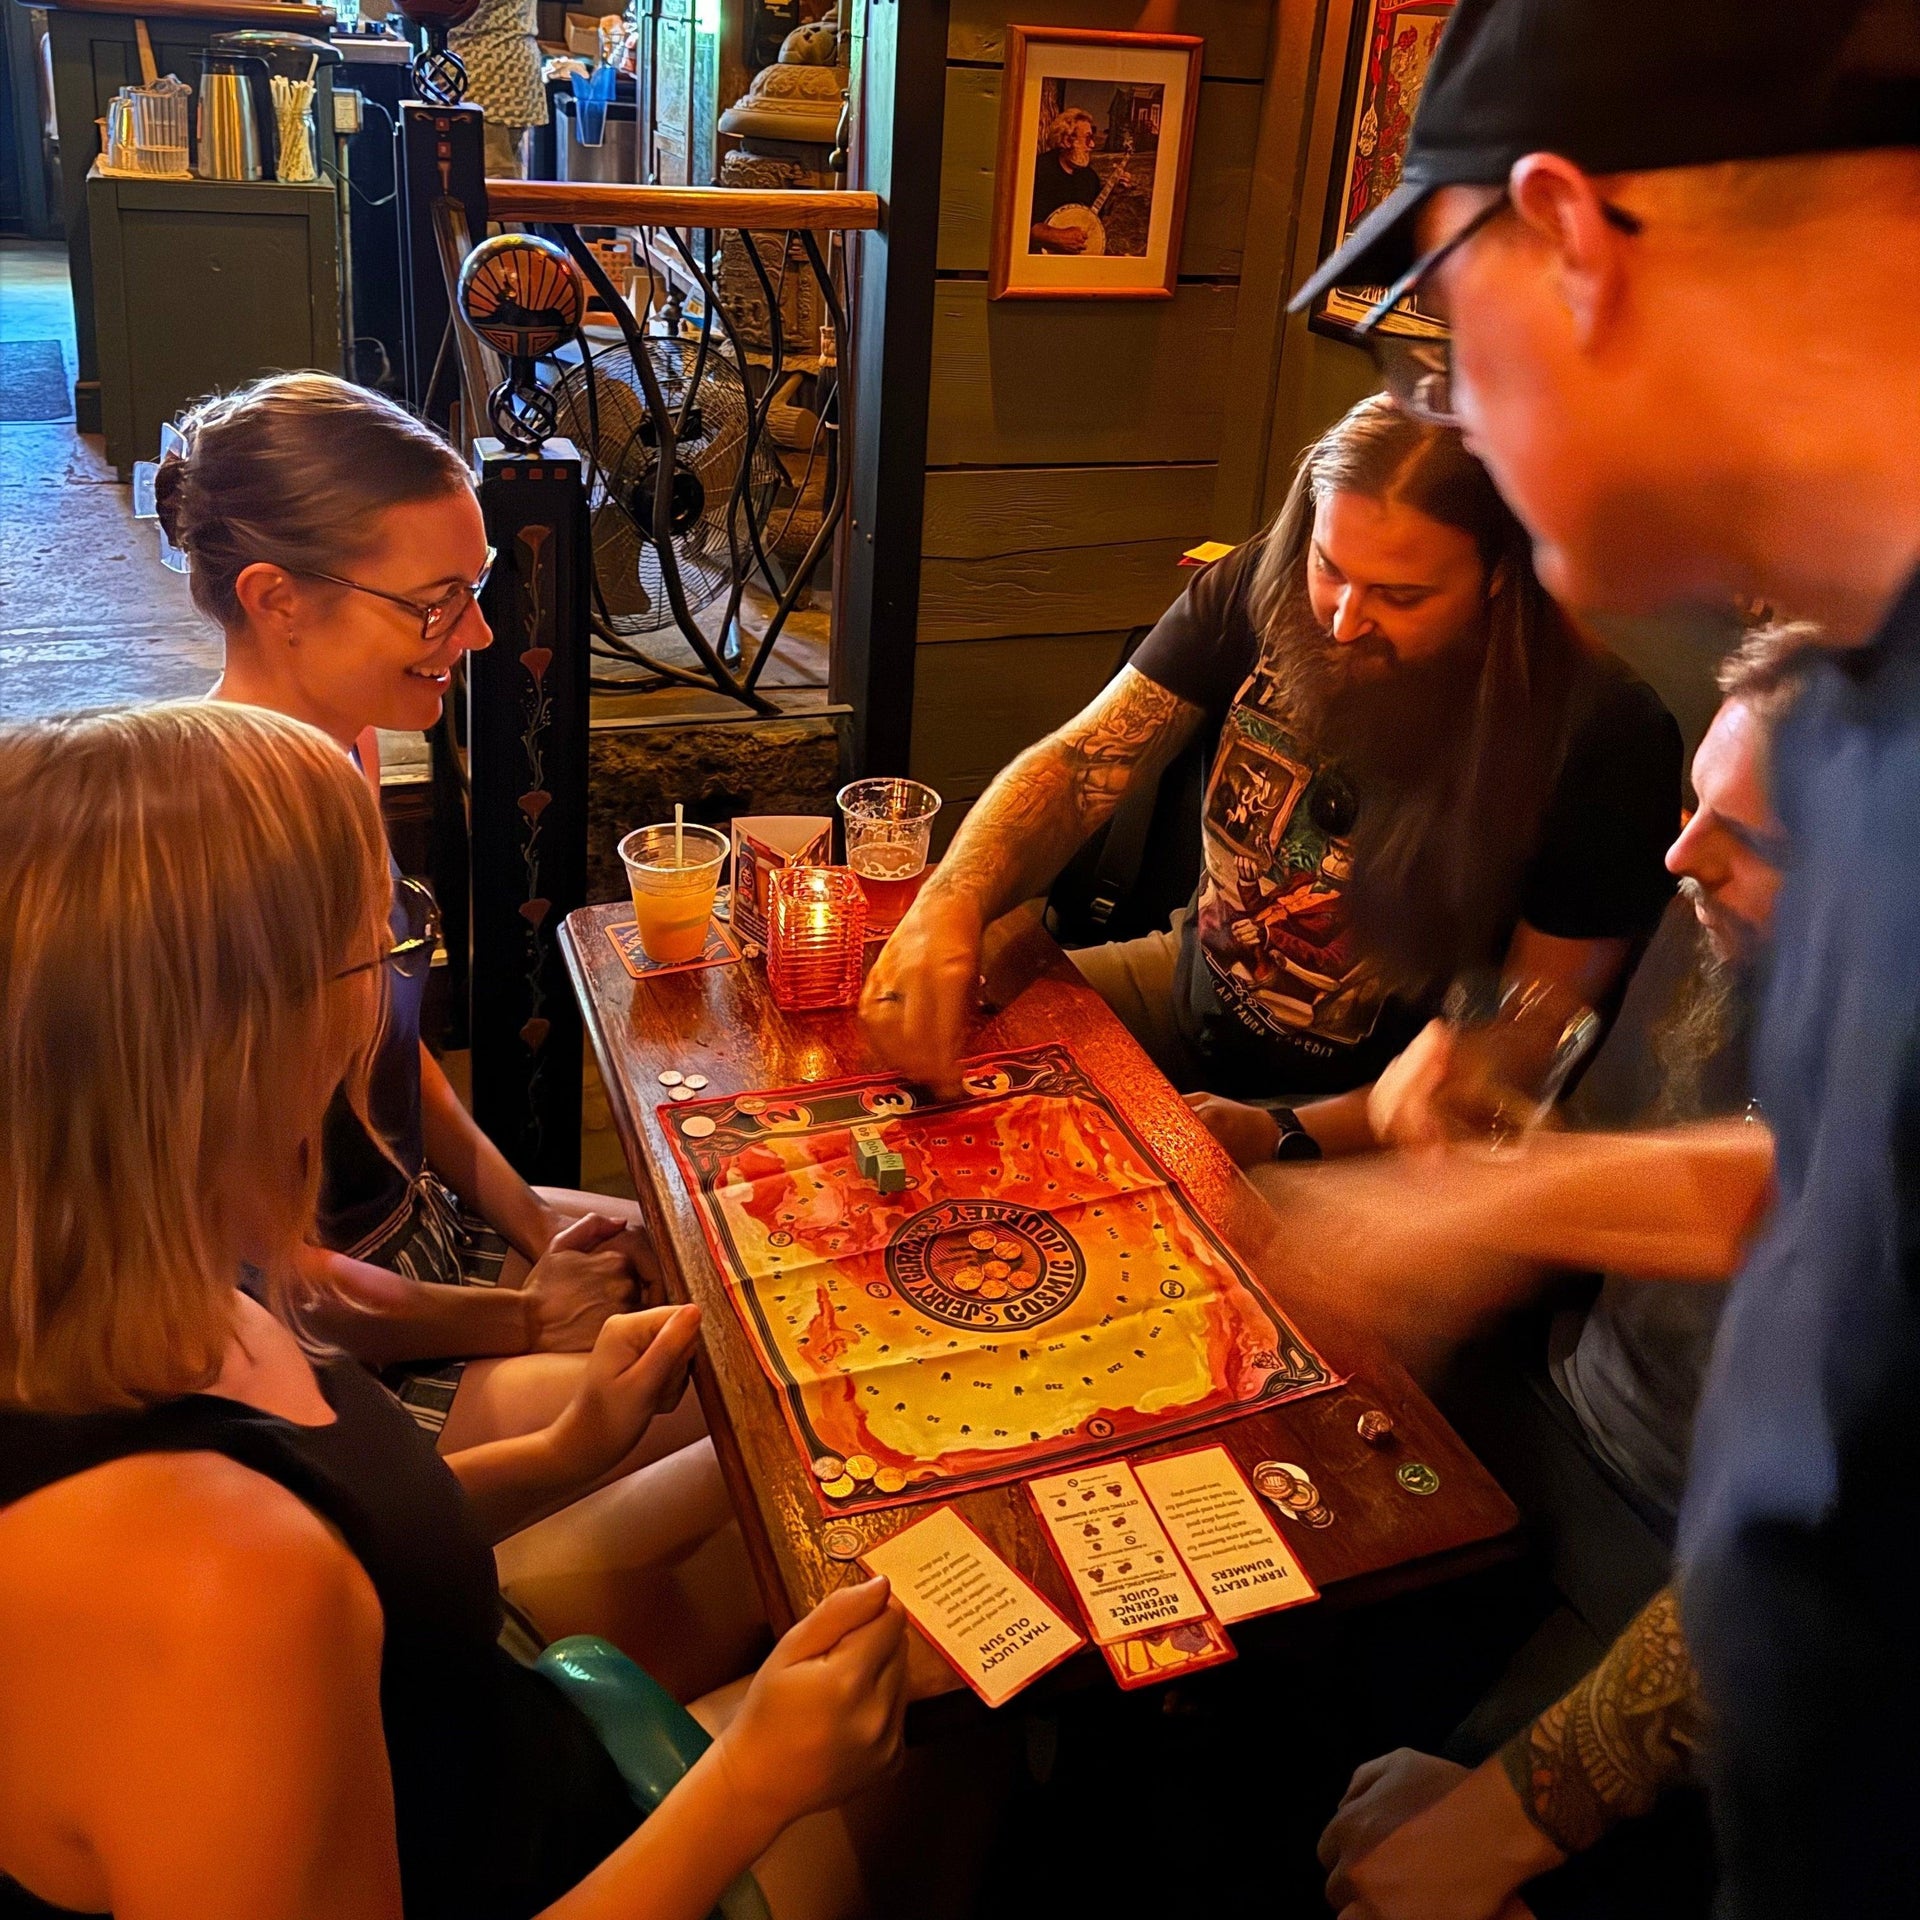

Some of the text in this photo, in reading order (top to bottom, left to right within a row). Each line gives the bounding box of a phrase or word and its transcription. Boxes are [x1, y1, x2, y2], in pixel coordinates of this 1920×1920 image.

[968, 1075, 997, 1090] 4
[872, 1093, 905, 1106] 3
[767, 1109, 800, 1123] 2
[865, 1140, 879, 1154] 100
[949, 1206, 1075, 1322] COSMIC JOURNEY
[909, 1283, 981, 1321] JERRY
[1107, 1362, 1124, 1373] 220
[866, 1385, 880, 1396] 60
[973, 1380, 993, 1390] 240
[1044, 1382, 1064, 1391] 230
[927, 1415, 941, 1424] 50
[994, 1429, 1008, 1437] 40
[1062, 1427, 1076, 1436] 30
[1211, 1558, 1275, 1582] BUMMERS
[1211, 1566, 1289, 1595] JERRY BEATS
[1118, 1587, 1160, 1604] GUIDE
[1109, 1594, 1180, 1618] REFERENCE
[1119, 1605, 1179, 1627] BUMMER
[979, 1617, 1030, 1655] OLD SUN
[980, 1621, 1051, 1673] THAT LUCKY
